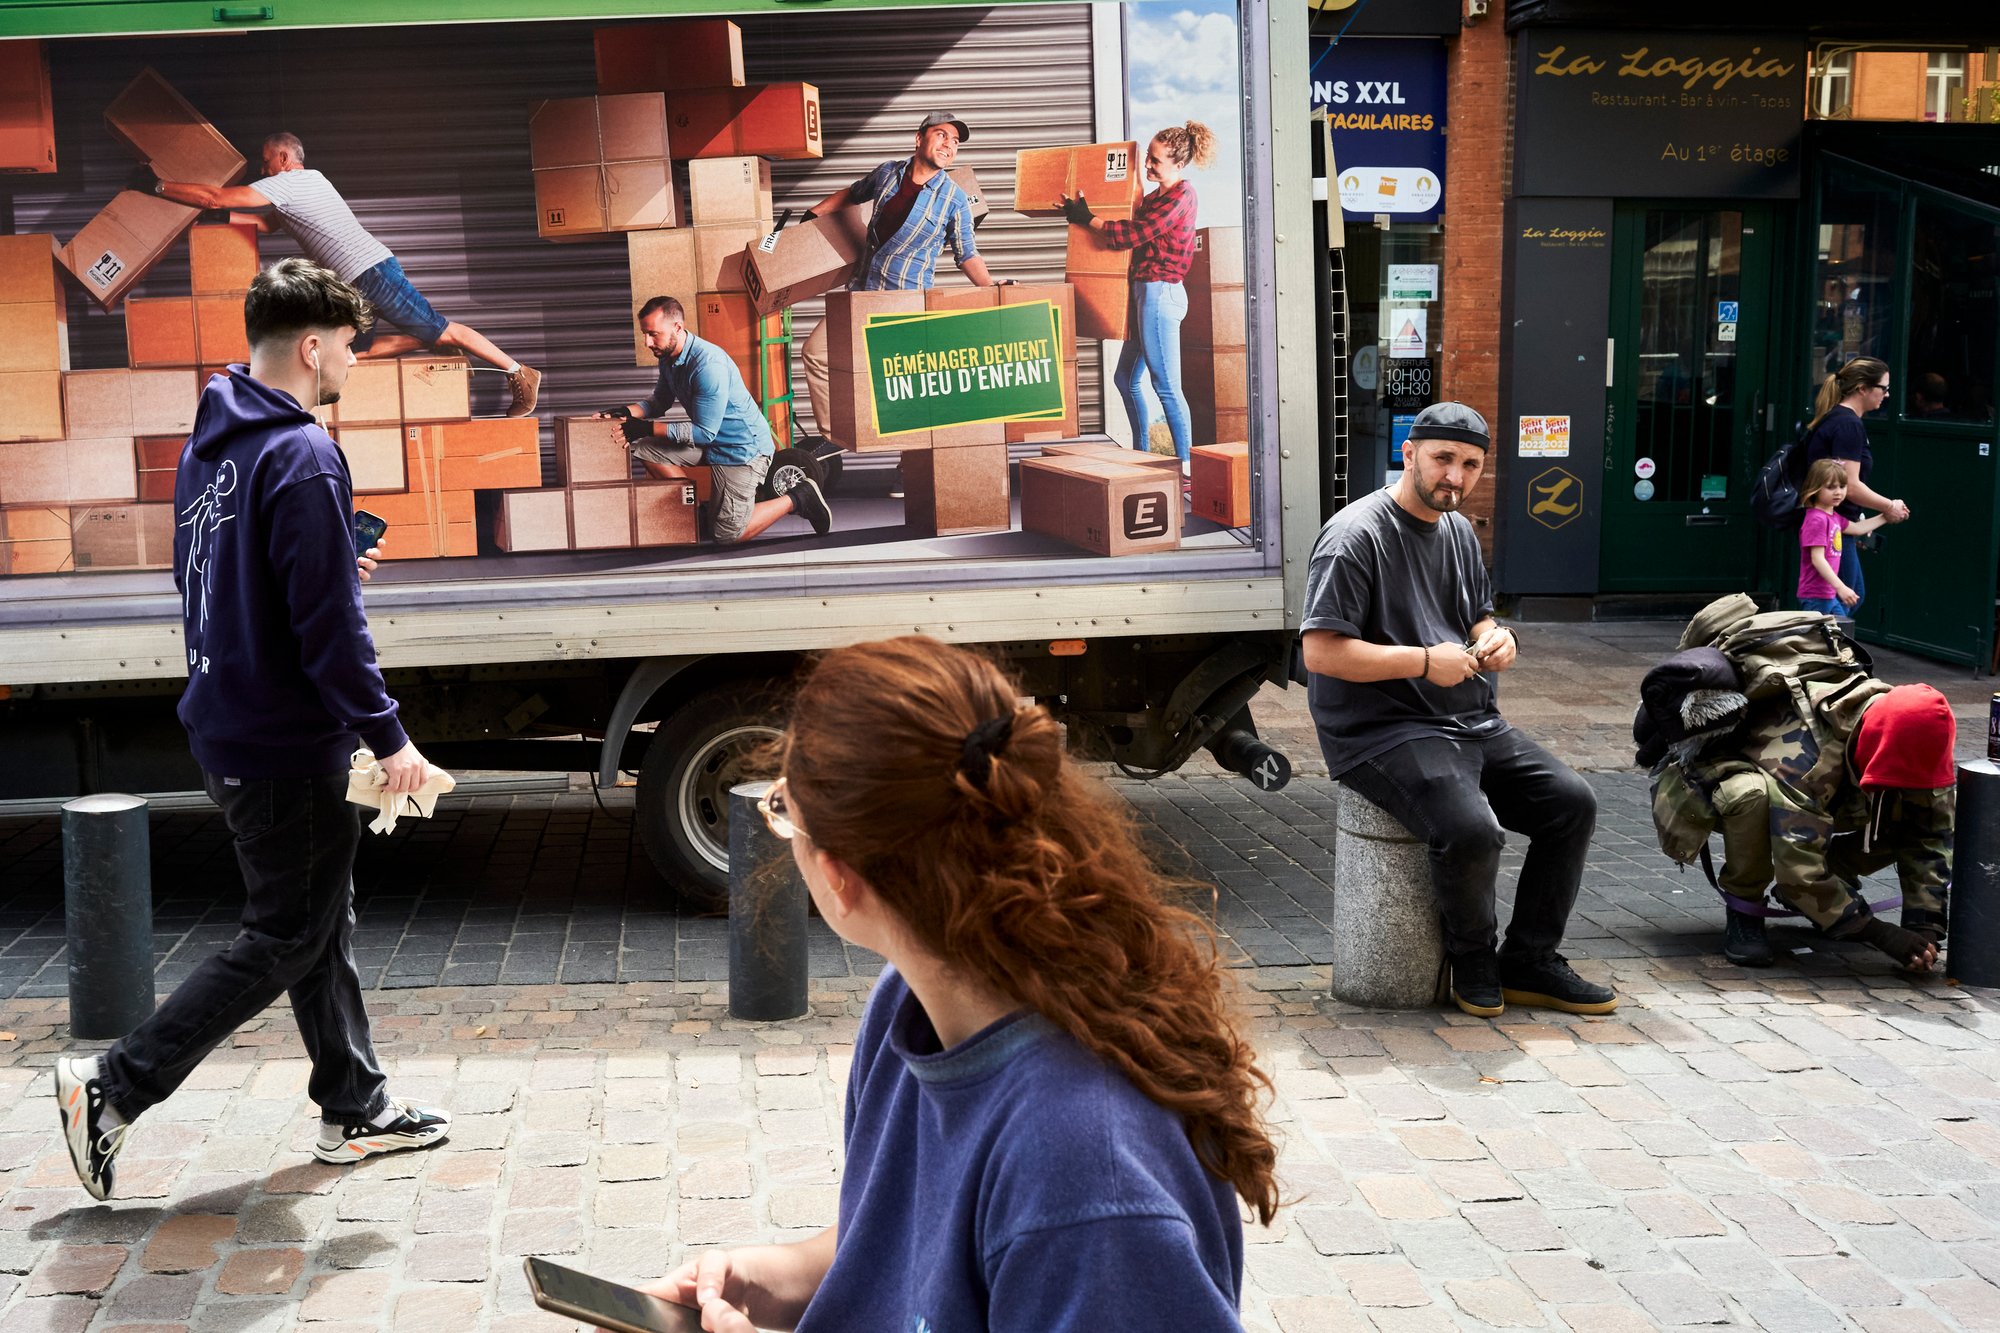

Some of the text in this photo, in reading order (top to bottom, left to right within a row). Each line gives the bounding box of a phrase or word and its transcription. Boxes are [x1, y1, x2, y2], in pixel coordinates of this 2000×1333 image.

[1535, 45, 1796, 90] La Loggia
[1310, 81, 1406, 104] NS XXL
[1591, 92, 1668, 106] Restaurant
[1680, 93, 1702, 107] Bar
[1718, 94, 1738, 107] vin
[1751, 94, 1792, 108] Tapas
[1661, 143, 1690, 161] Au
[1730, 143, 1790, 168] étage
[1522, 227, 1607, 242] La Loggia
[882, 339, 1049, 378] DÉMÉNAGER DEVIENT
[885, 358, 1052, 401] UN JEU D'ENFANT
[1386, 368, 1431, 382] 10H00
[1385, 382, 1431, 395] 19H30
[1521, 420, 1542, 430] petit
[1546, 419, 1567, 430] petit
[1135, 497, 1158, 525] E
